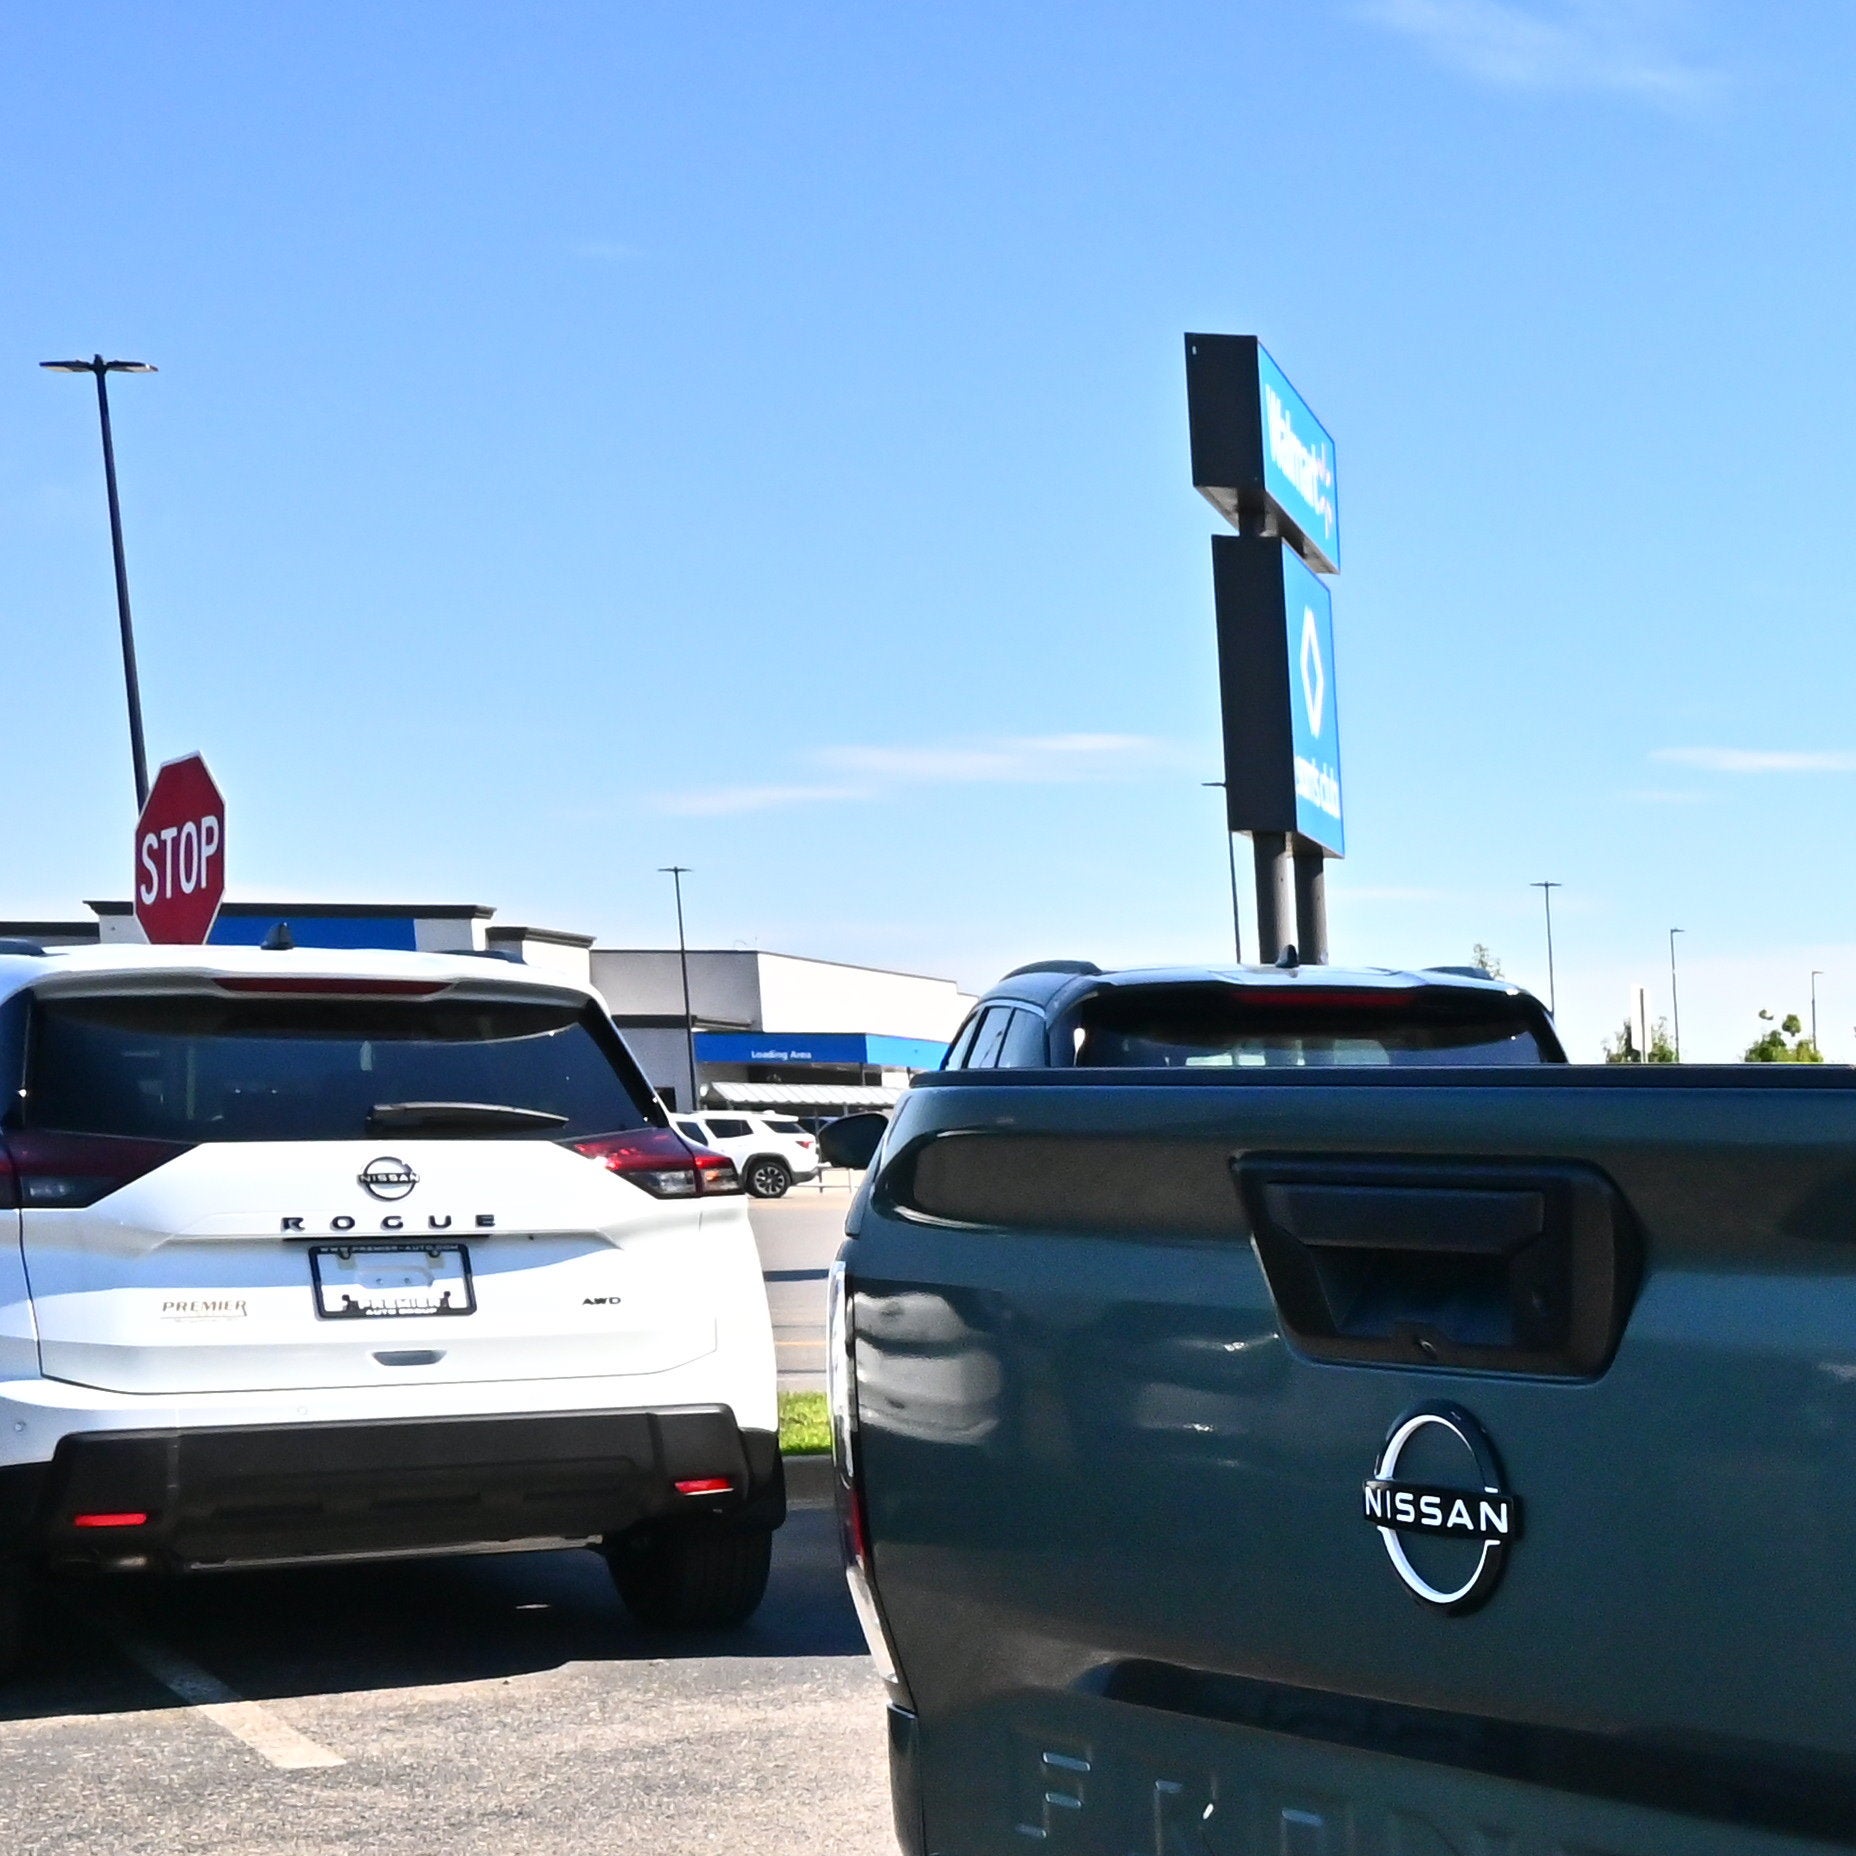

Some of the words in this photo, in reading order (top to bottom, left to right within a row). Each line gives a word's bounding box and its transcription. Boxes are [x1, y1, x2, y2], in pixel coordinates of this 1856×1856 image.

[140, 815, 219, 905] STOP
[751, 1050, 788, 1060] Loading
[790, 1050, 812, 1059] Area
[360, 1173, 420, 1183] NISSAN
[281, 1214, 496, 1232] ROGUE
[162, 1300, 247, 1316] PREMIER
[582, 1297, 621, 1305] AWD
[1365, 1487, 1508, 1533] NISSAN
